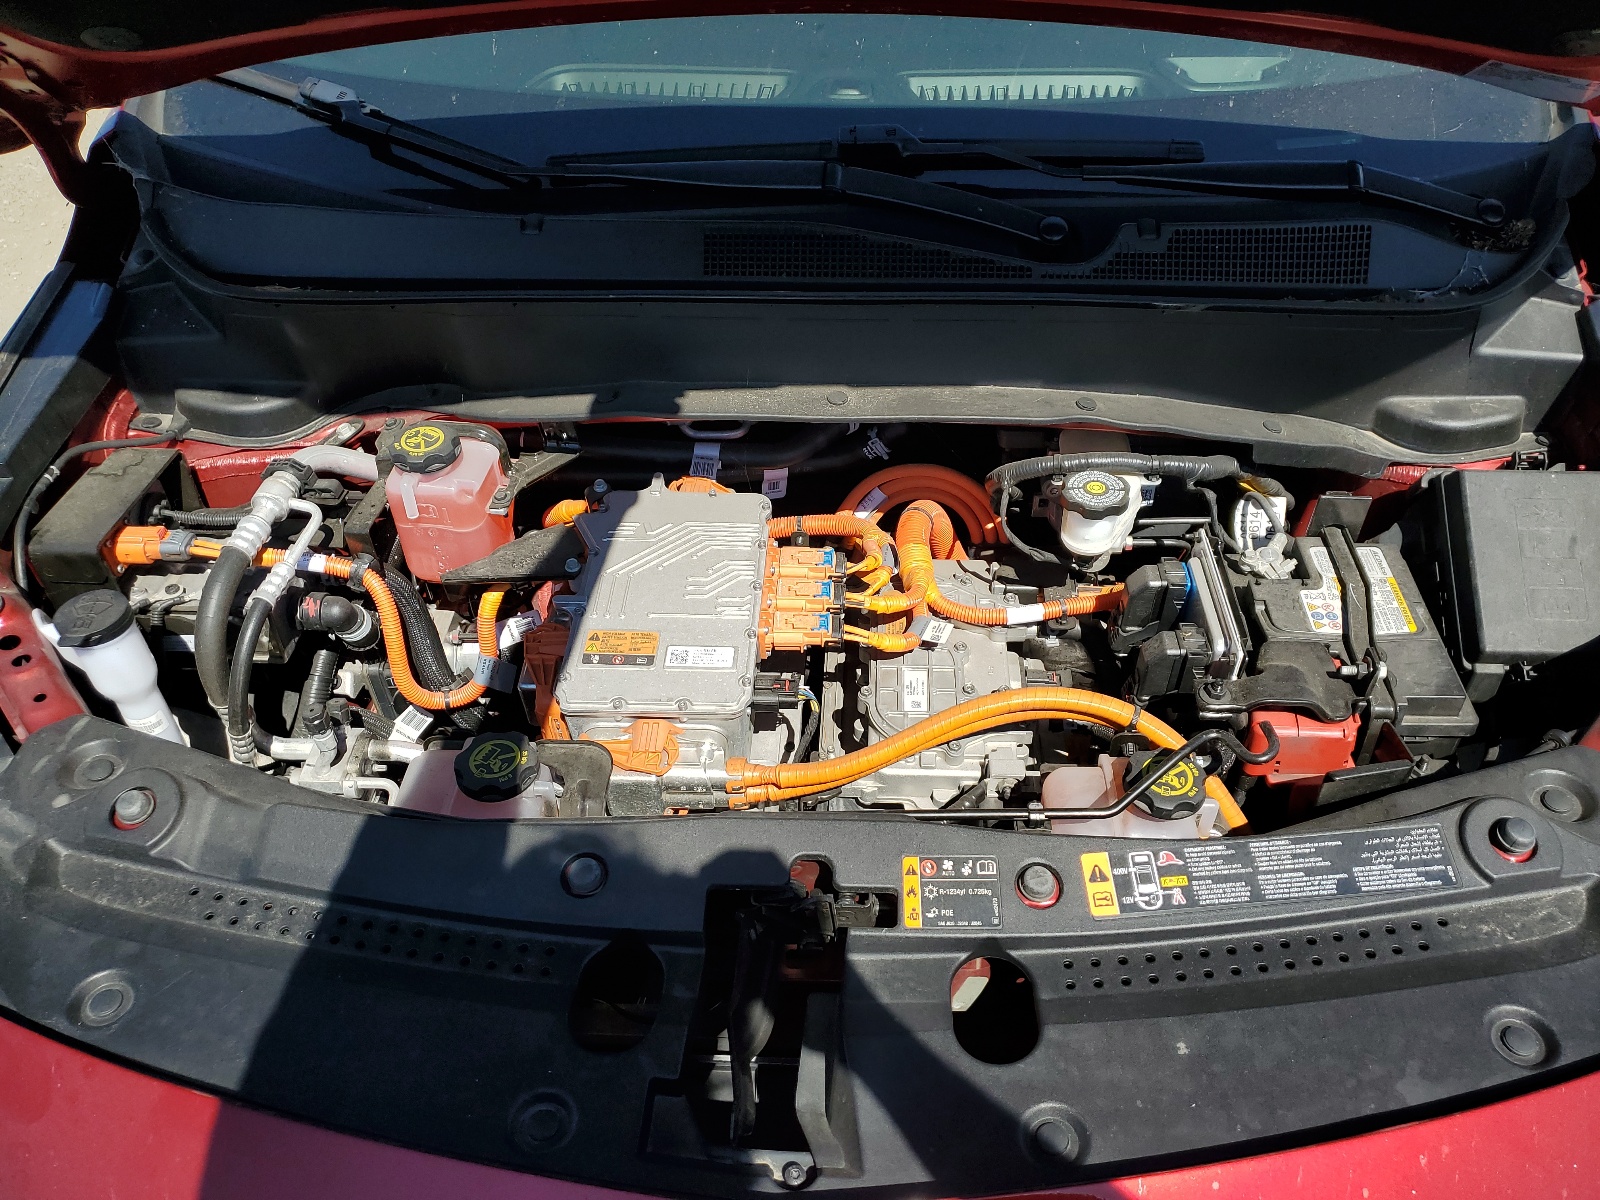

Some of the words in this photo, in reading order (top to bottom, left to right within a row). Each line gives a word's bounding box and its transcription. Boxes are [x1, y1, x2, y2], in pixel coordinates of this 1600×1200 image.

[1249, 511, 1260, 539] 0614
[1112, 867, 1128, 875] 400V
[968, 888, 992, 896] 0.725kg
[1122, 896, 1134, 904] 12V
[941, 909, 954, 917] POE
